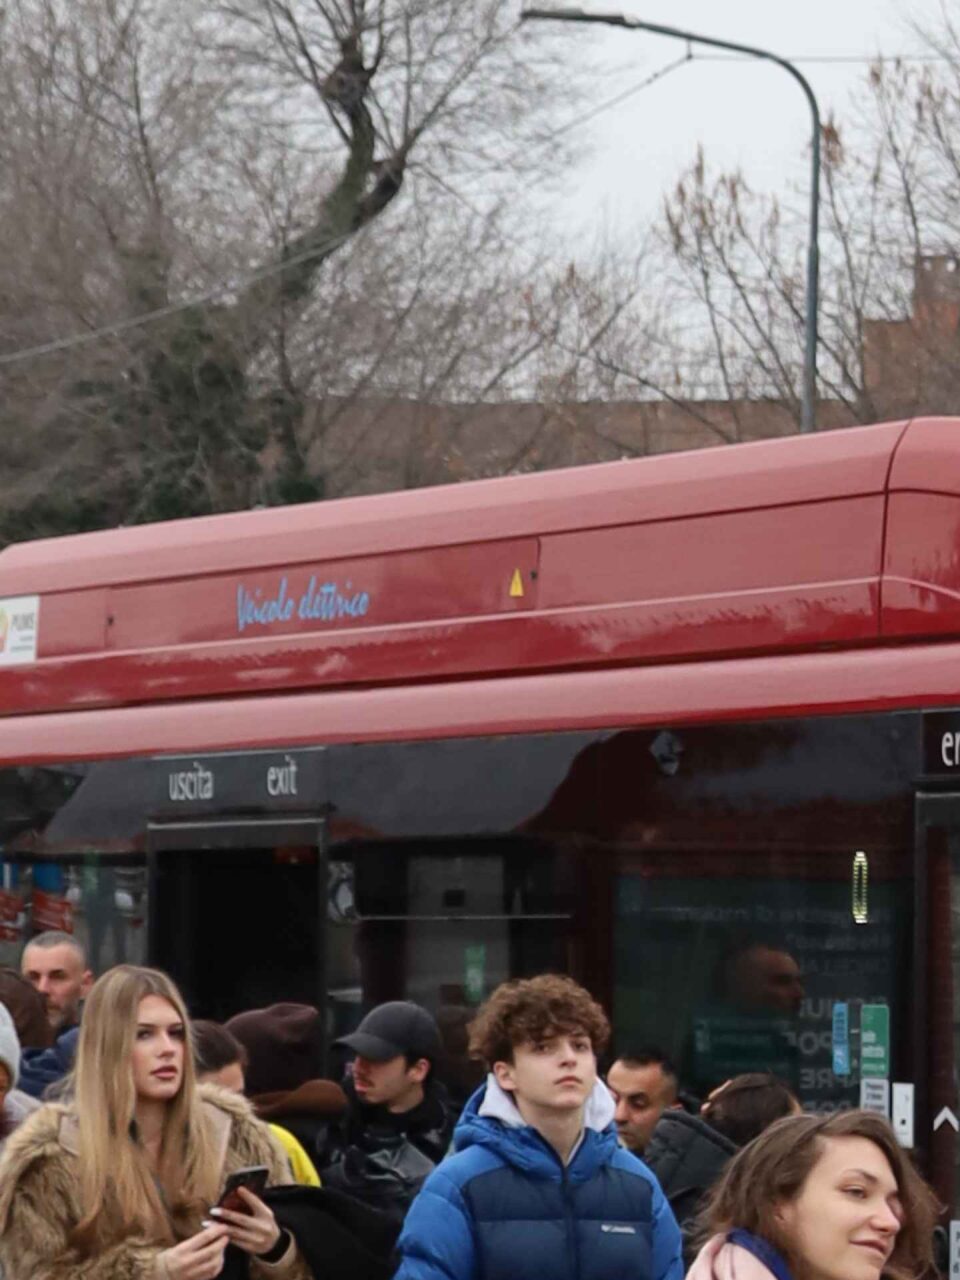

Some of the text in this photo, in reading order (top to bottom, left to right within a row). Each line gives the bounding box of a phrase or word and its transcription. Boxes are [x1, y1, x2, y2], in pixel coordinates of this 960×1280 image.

[236, 574, 295, 633] Veicolo
[168, 754, 298, 801] uscita exit
